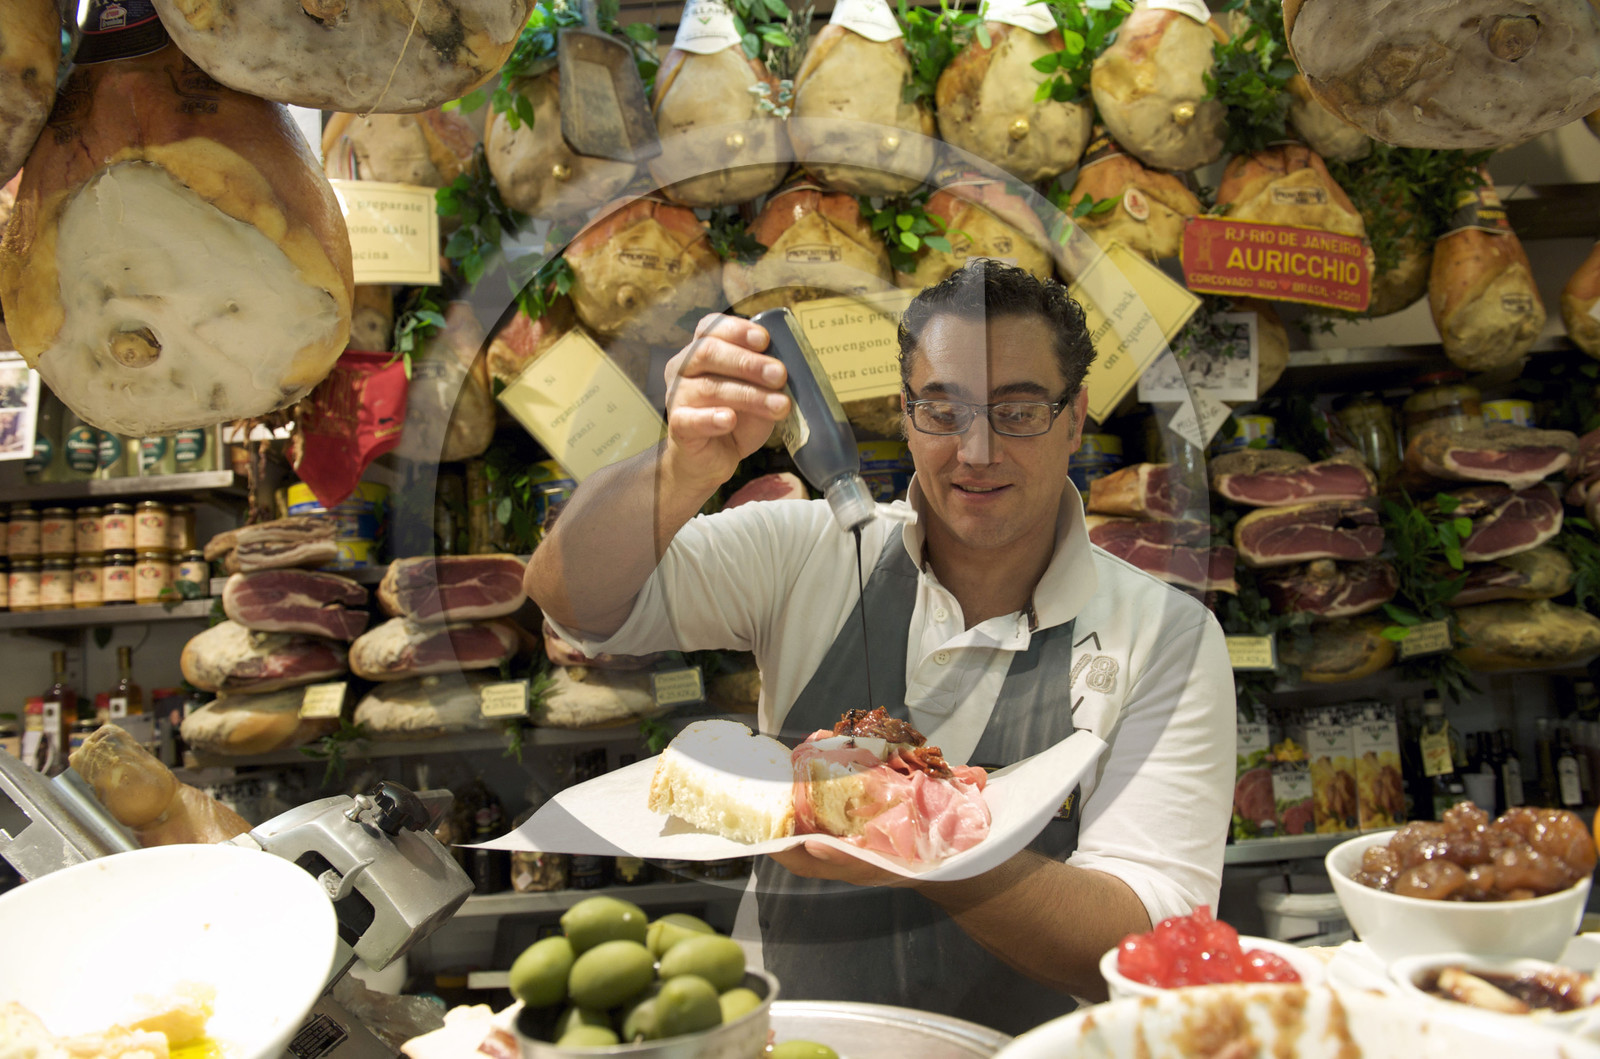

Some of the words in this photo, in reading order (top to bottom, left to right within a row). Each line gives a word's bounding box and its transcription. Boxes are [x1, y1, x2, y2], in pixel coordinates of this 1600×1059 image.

[357, 200, 423, 212] preparate
[383, 223, 417, 236] dalla
[1278, 232, 1298, 247] DE
[1302, 234, 1362, 257] JANEIRO
[1225, 247, 1361, 286] AURICCHIO
[1291, 282, 1329, 298] BRASIL
[1112, 290, 1137, 320] pack
[809, 318, 825, 331] Le
[831, 313, 864, 328] salse
[1103, 353, 1119, 370] on
[1117, 312, 1153, 354] request
[543, 375, 556, 386] Si
[551, 384, 600, 429] organizzano
[567, 420, 596, 448] pranzi
[606, 402, 618, 414] di
[592, 431, 622, 457] lavoro
